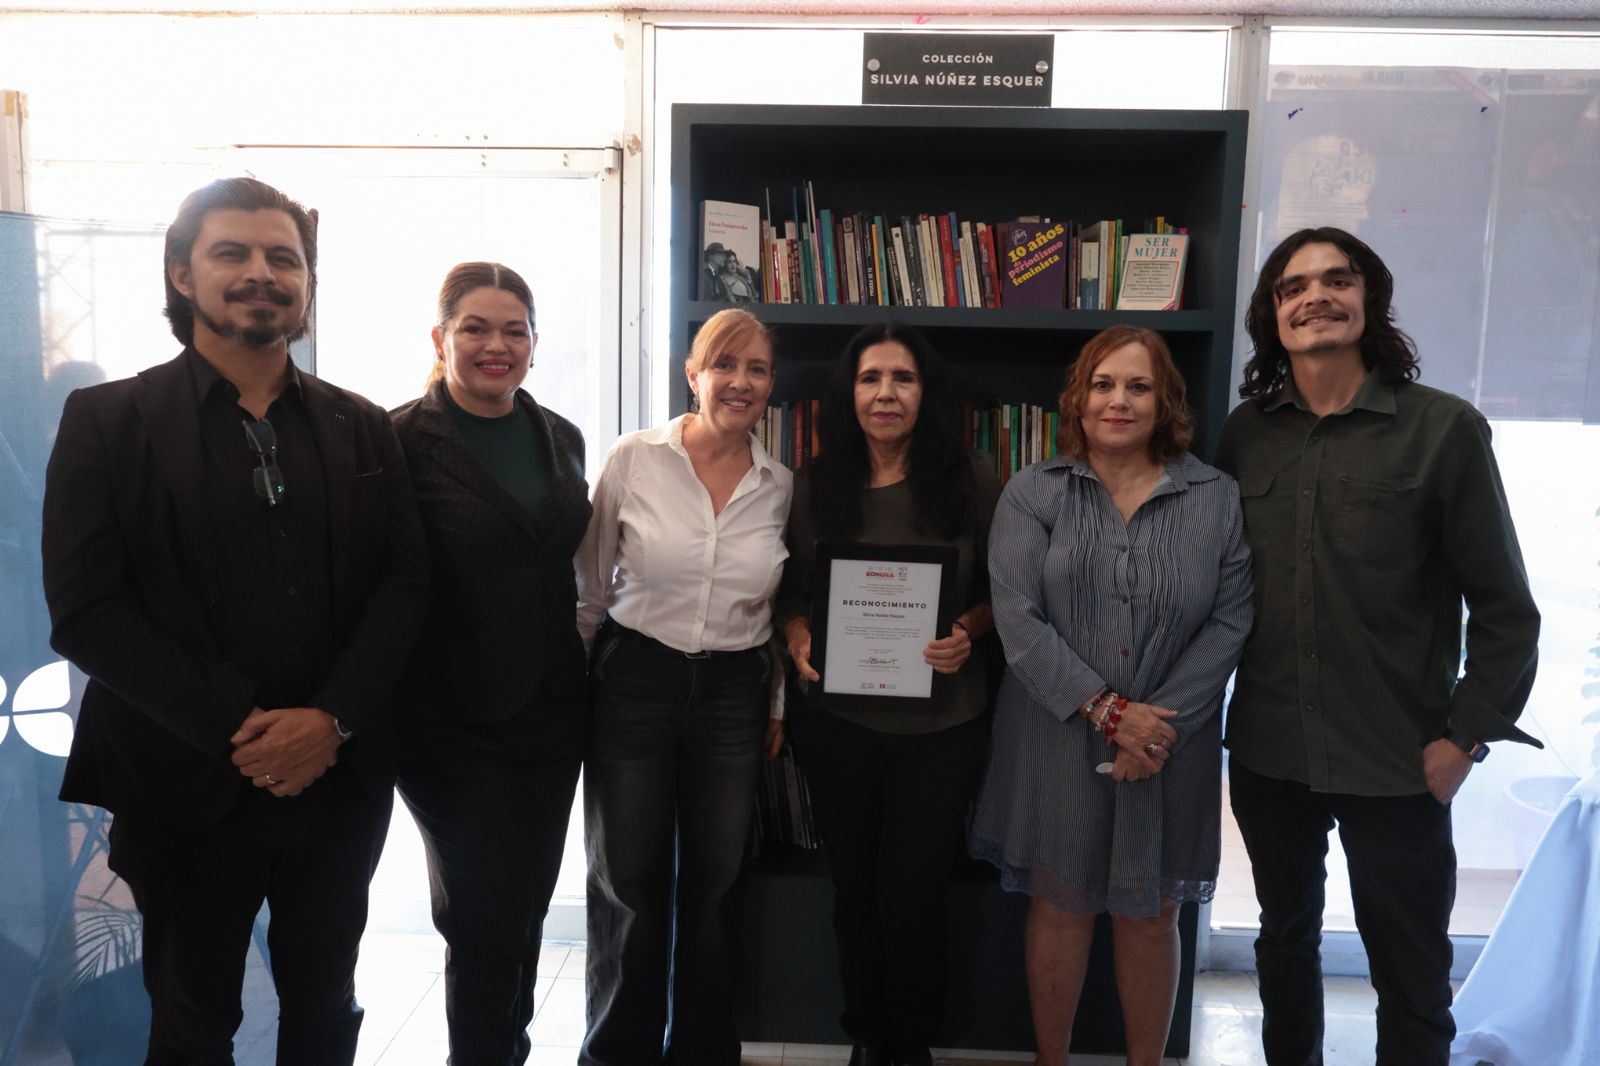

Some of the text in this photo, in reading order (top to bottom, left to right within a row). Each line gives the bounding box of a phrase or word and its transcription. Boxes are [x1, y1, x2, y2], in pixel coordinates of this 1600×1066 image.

[922, 53, 993, 64] COLECCIÓN
[870, 72, 1044, 88] SILVIA NÚÑEZ ESQUER
[1008, 245, 1027, 262] 10
[1027, 224, 1065, 252] años
[1144, 237, 1170, 247] SER
[1008, 241, 1063, 278] periodismo
[1134, 247, 1178, 260] MUJER
[1012, 254, 1060, 287] feminista
[842, 599, 927, 609] RECONOCIMIENTO
